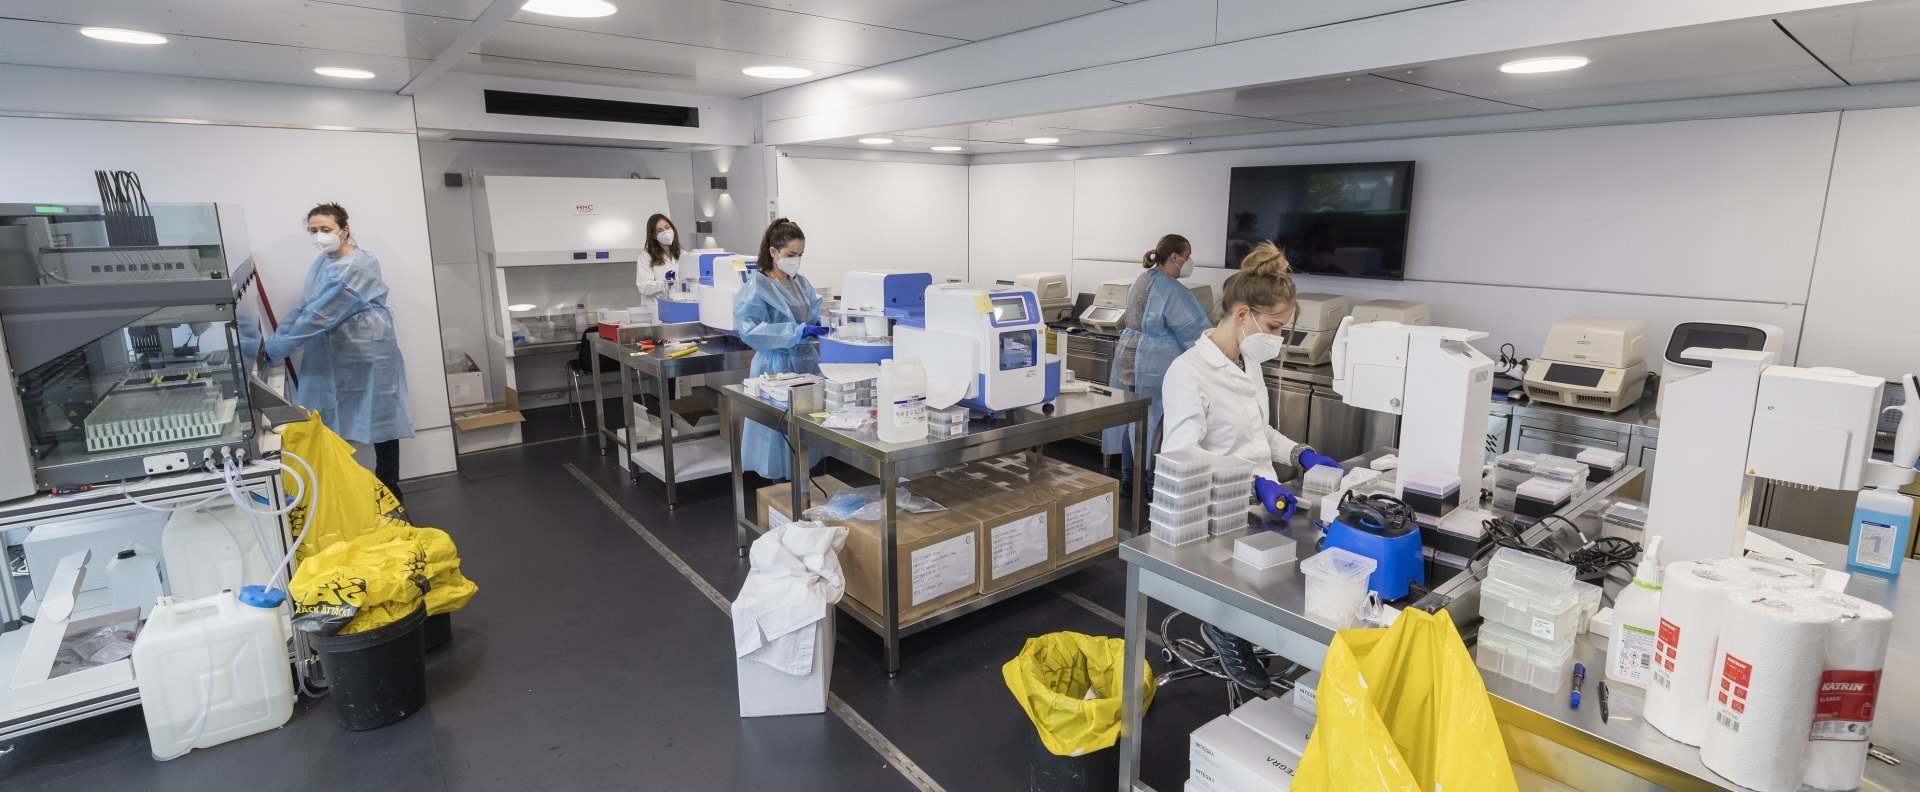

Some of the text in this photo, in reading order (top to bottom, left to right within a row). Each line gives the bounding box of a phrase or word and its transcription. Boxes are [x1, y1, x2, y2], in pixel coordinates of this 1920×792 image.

[1822, 682, 1864, 691] KATRIN
[1300, 688, 1316, 699] INTEGR
[1195, 742, 1215, 757] INTEGRA
[1266, 755, 1294, 777] EGRA
